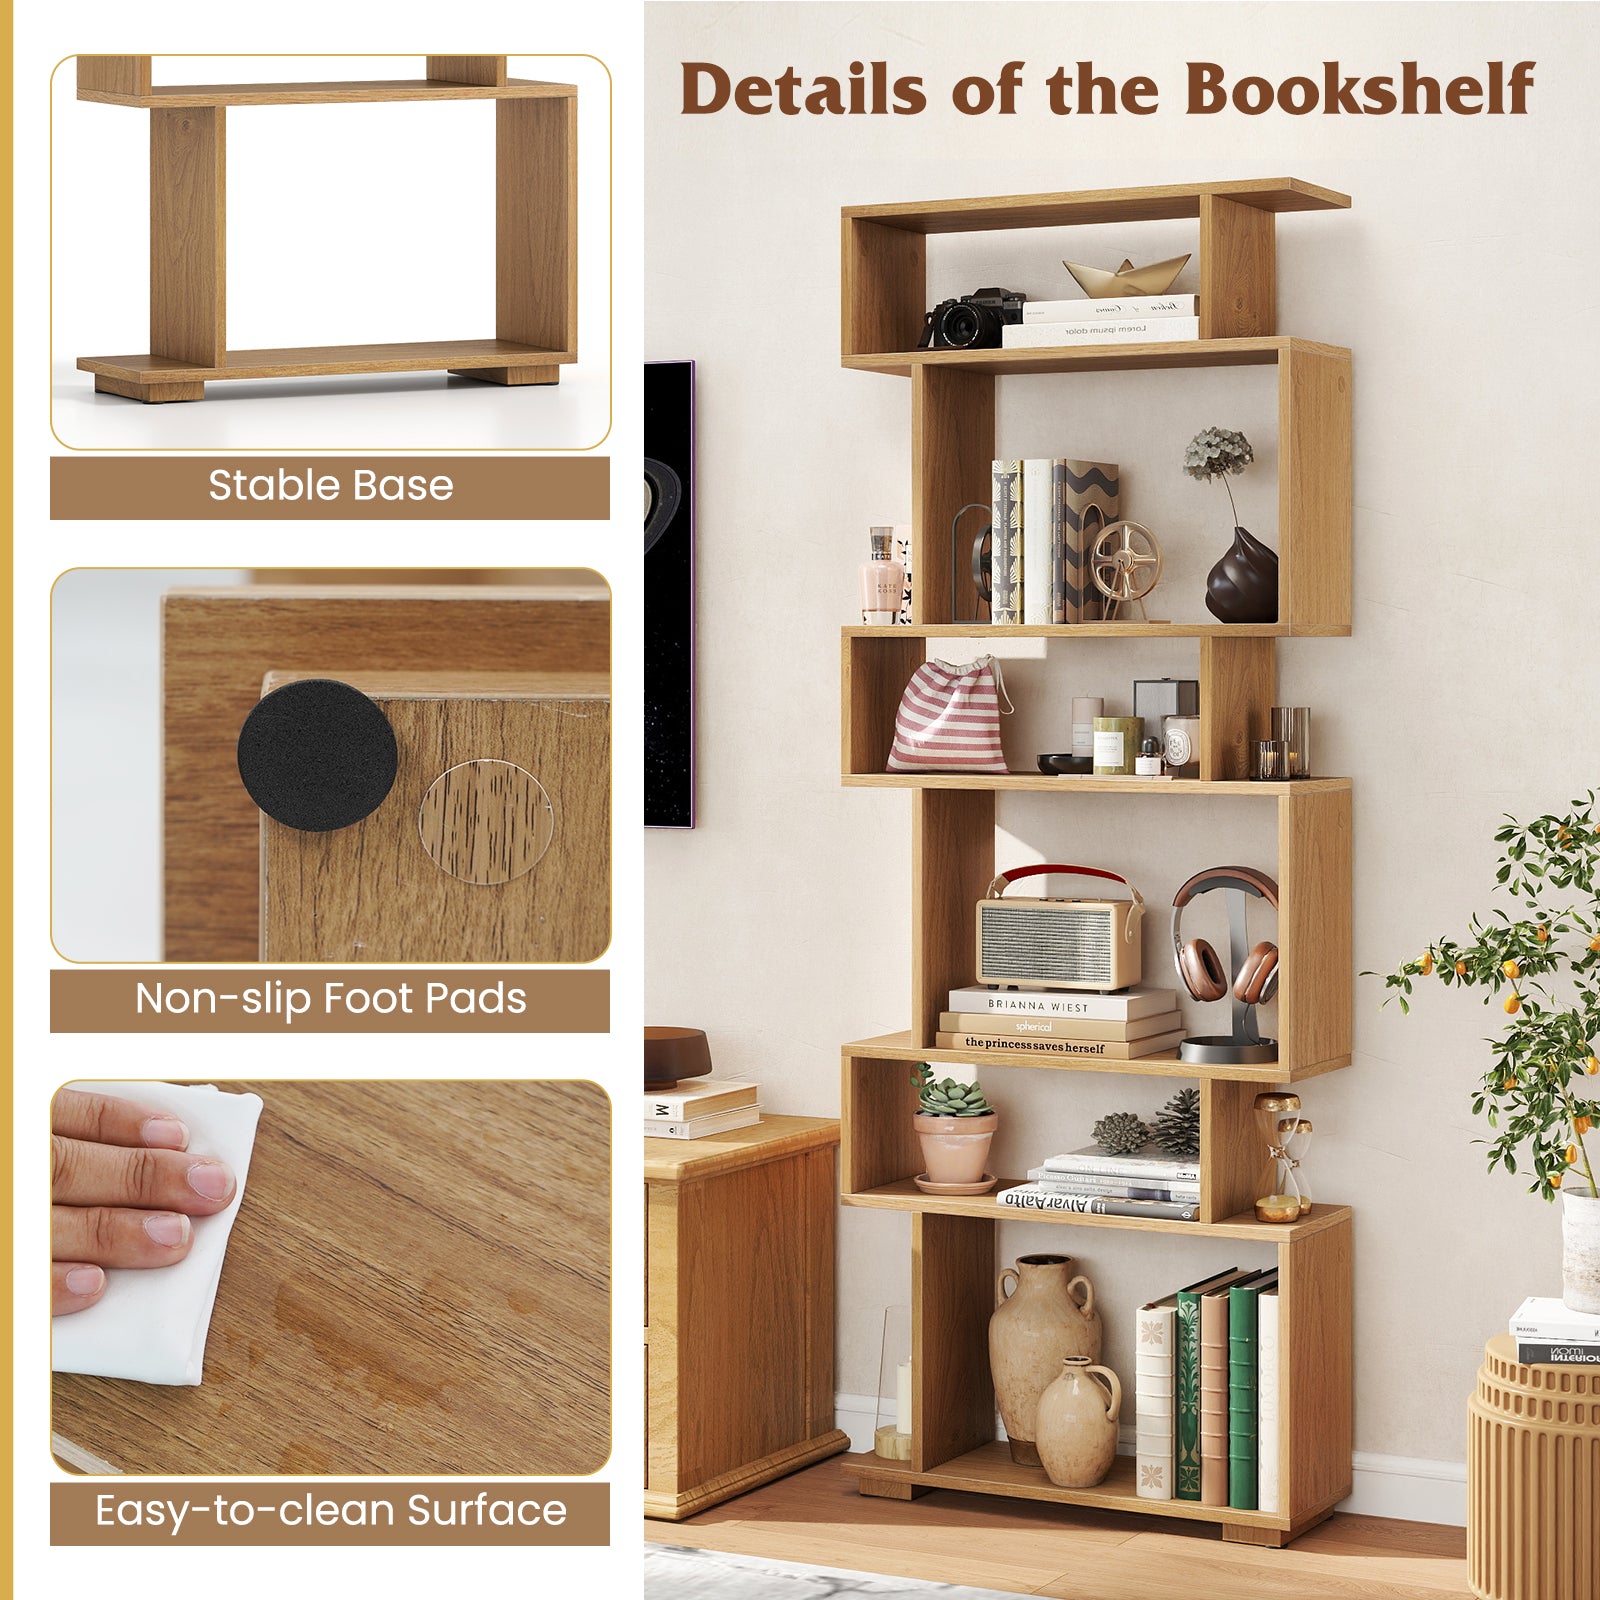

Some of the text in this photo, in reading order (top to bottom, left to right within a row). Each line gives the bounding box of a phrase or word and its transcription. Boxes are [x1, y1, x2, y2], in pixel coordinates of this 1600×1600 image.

[988, 999, 1088, 1013] BRIANNA WIEST
[1015, 1020, 1052, 1032] spherical
[965, 1037, 1106, 1054] the princess saves herself
[1038, 1172, 1066, 1181] Picasso
